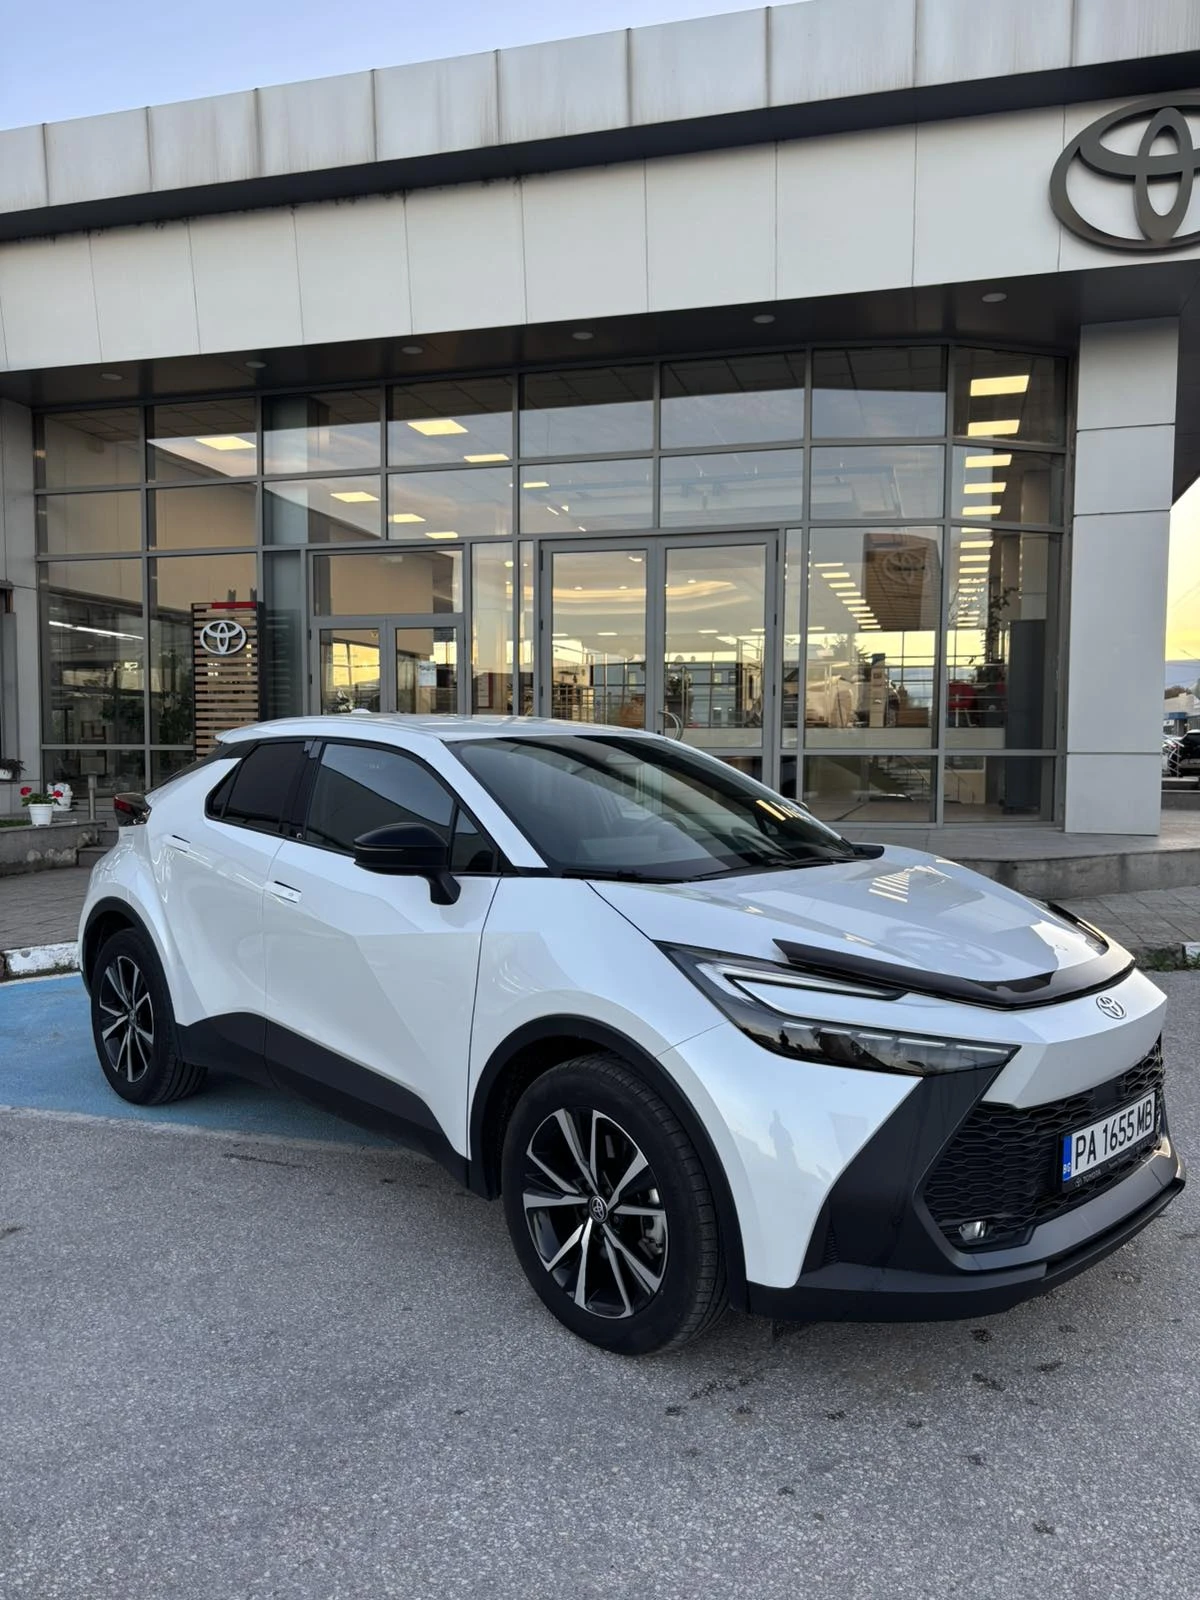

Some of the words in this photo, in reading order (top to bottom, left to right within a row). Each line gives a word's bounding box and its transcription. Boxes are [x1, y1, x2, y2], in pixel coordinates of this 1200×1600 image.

[1075, 1130, 1097, 1170] PA
[1102, 1110, 1135, 1156] 1655
[1136, 1101, 1152, 1137] MB
